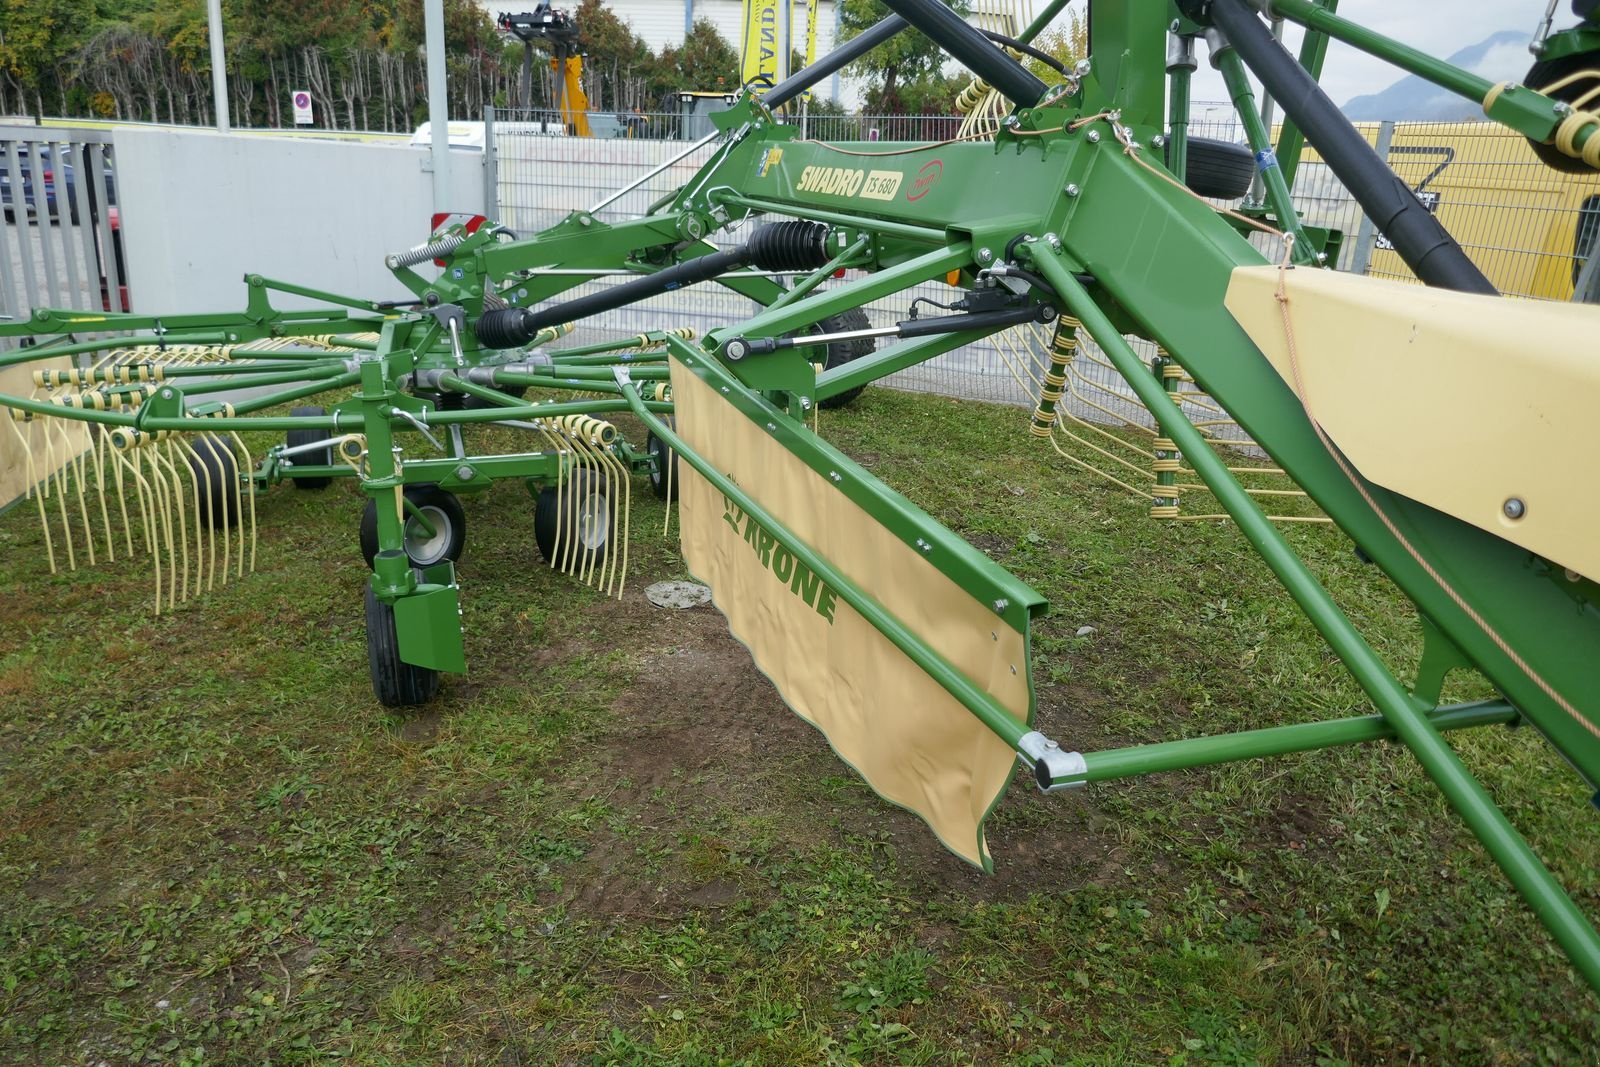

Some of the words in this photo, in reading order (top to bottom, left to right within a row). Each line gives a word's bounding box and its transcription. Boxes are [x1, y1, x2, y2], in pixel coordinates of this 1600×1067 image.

[797, 165, 864, 197] SWADRO
[866, 177, 877, 193] TS
[878, 178, 897, 195] 680
[743, 514, 837, 626] KRONE
